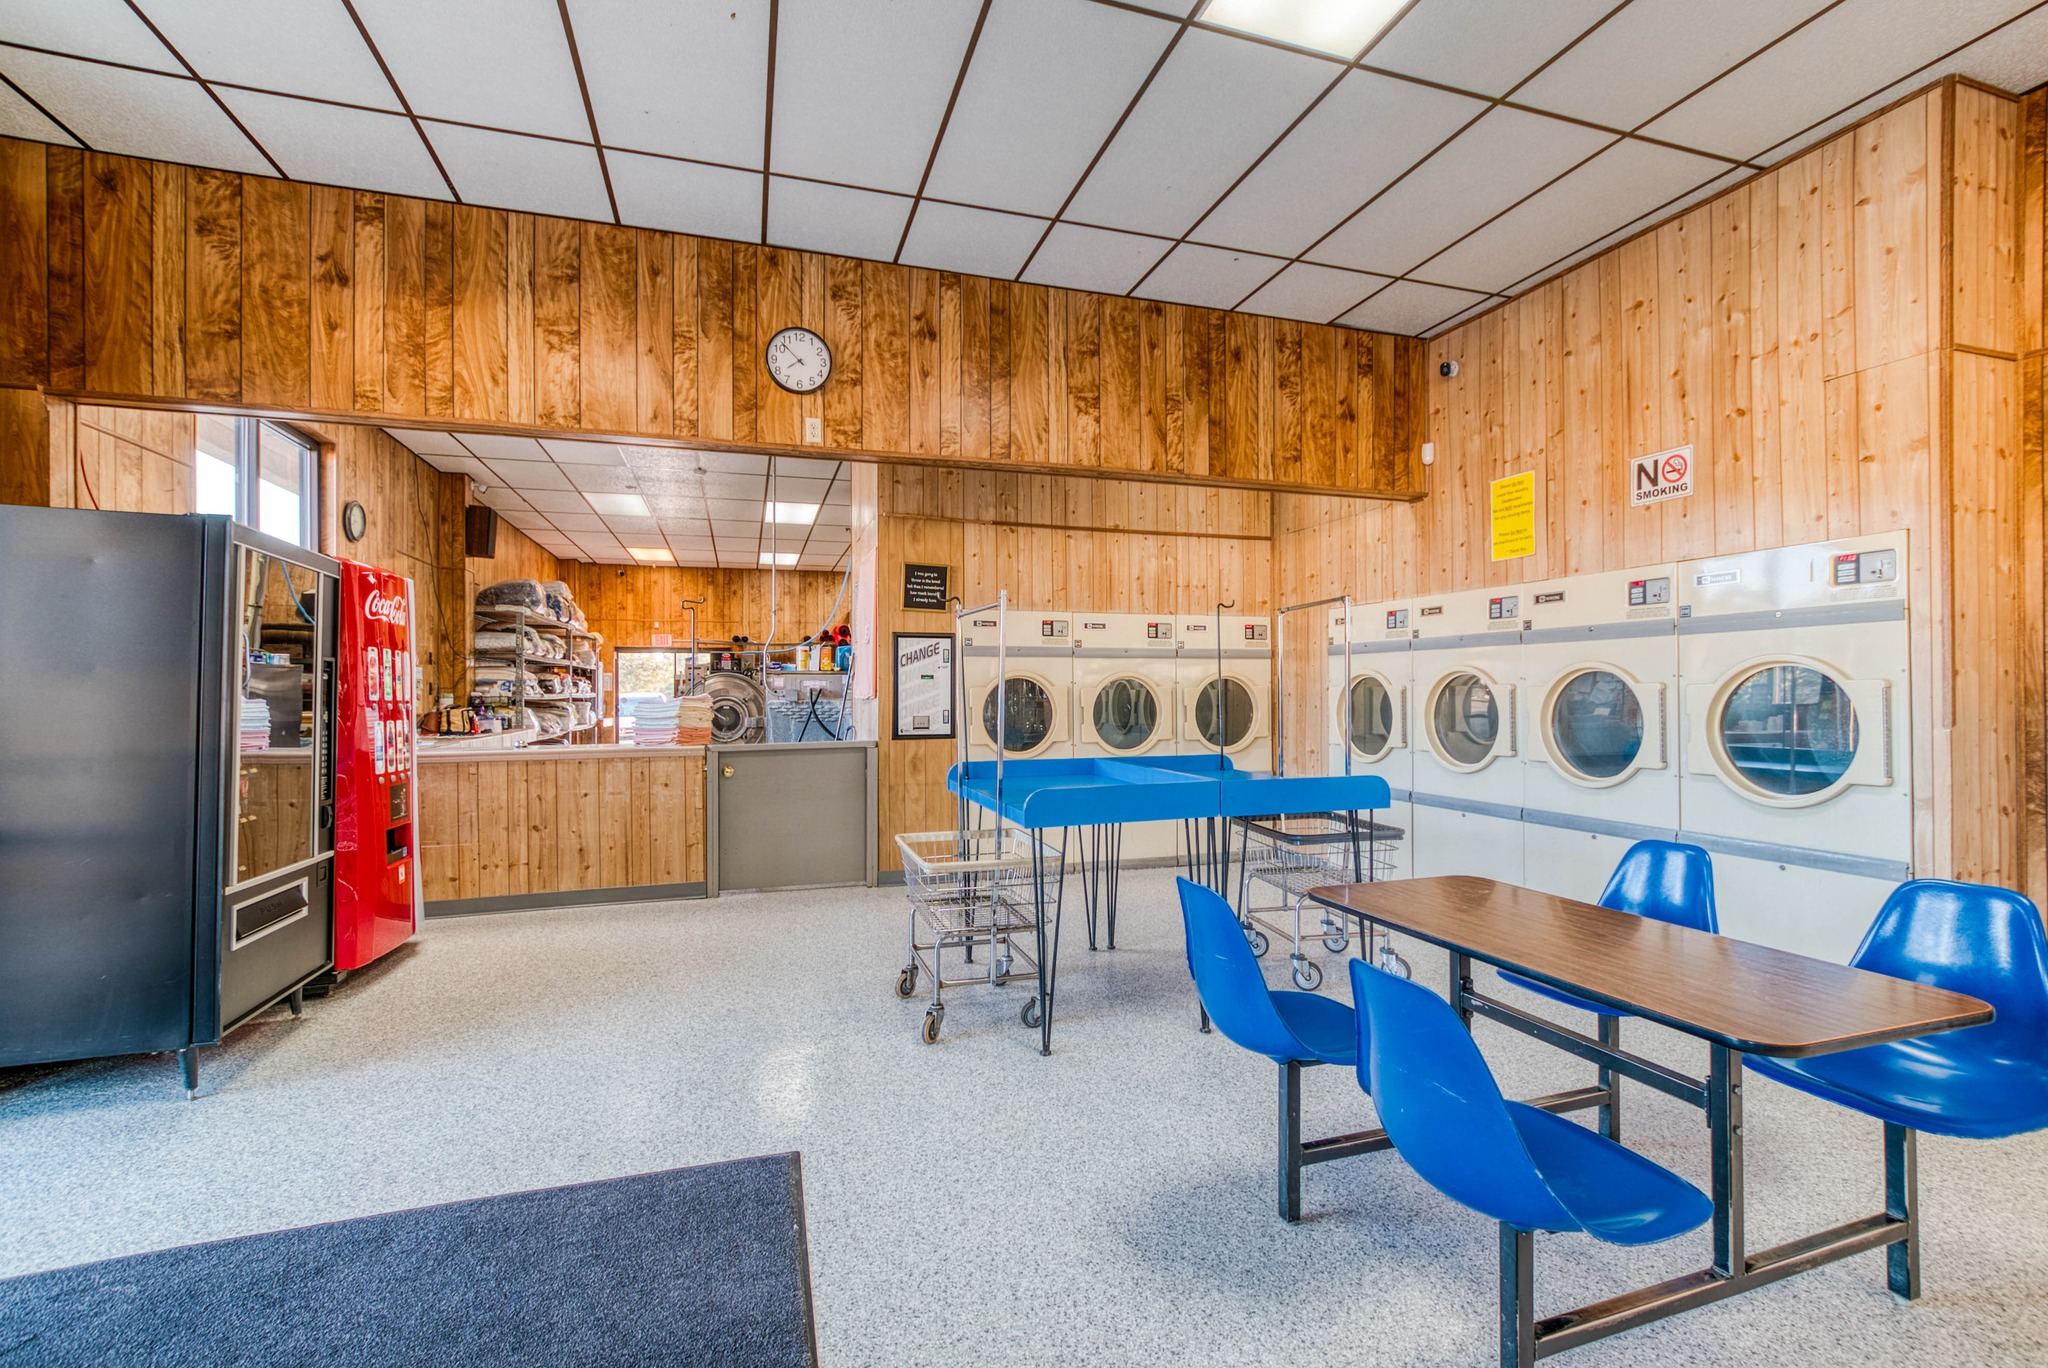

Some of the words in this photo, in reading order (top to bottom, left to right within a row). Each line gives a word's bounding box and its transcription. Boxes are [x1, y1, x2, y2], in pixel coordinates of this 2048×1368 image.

[782, 335, 792, 344] 11
[794, 332, 806, 342] 12
[774, 344, 786, 354] 10
[816, 347, 823, 356] 2
[770, 354, 778, 364] 9
[820, 358, 826, 368] 3
[774, 366, 782, 376] 8
[817, 370, 823, 378] 4
[784, 374, 790, 384] 7
[796, 379, 803, 389] 6
[809, 376, 816, 386] 5
[1636, 482, 1688, 500] SMOKING
[900, 642, 940, 667] CHANGE
[260, 901, 282, 915] PUSH
